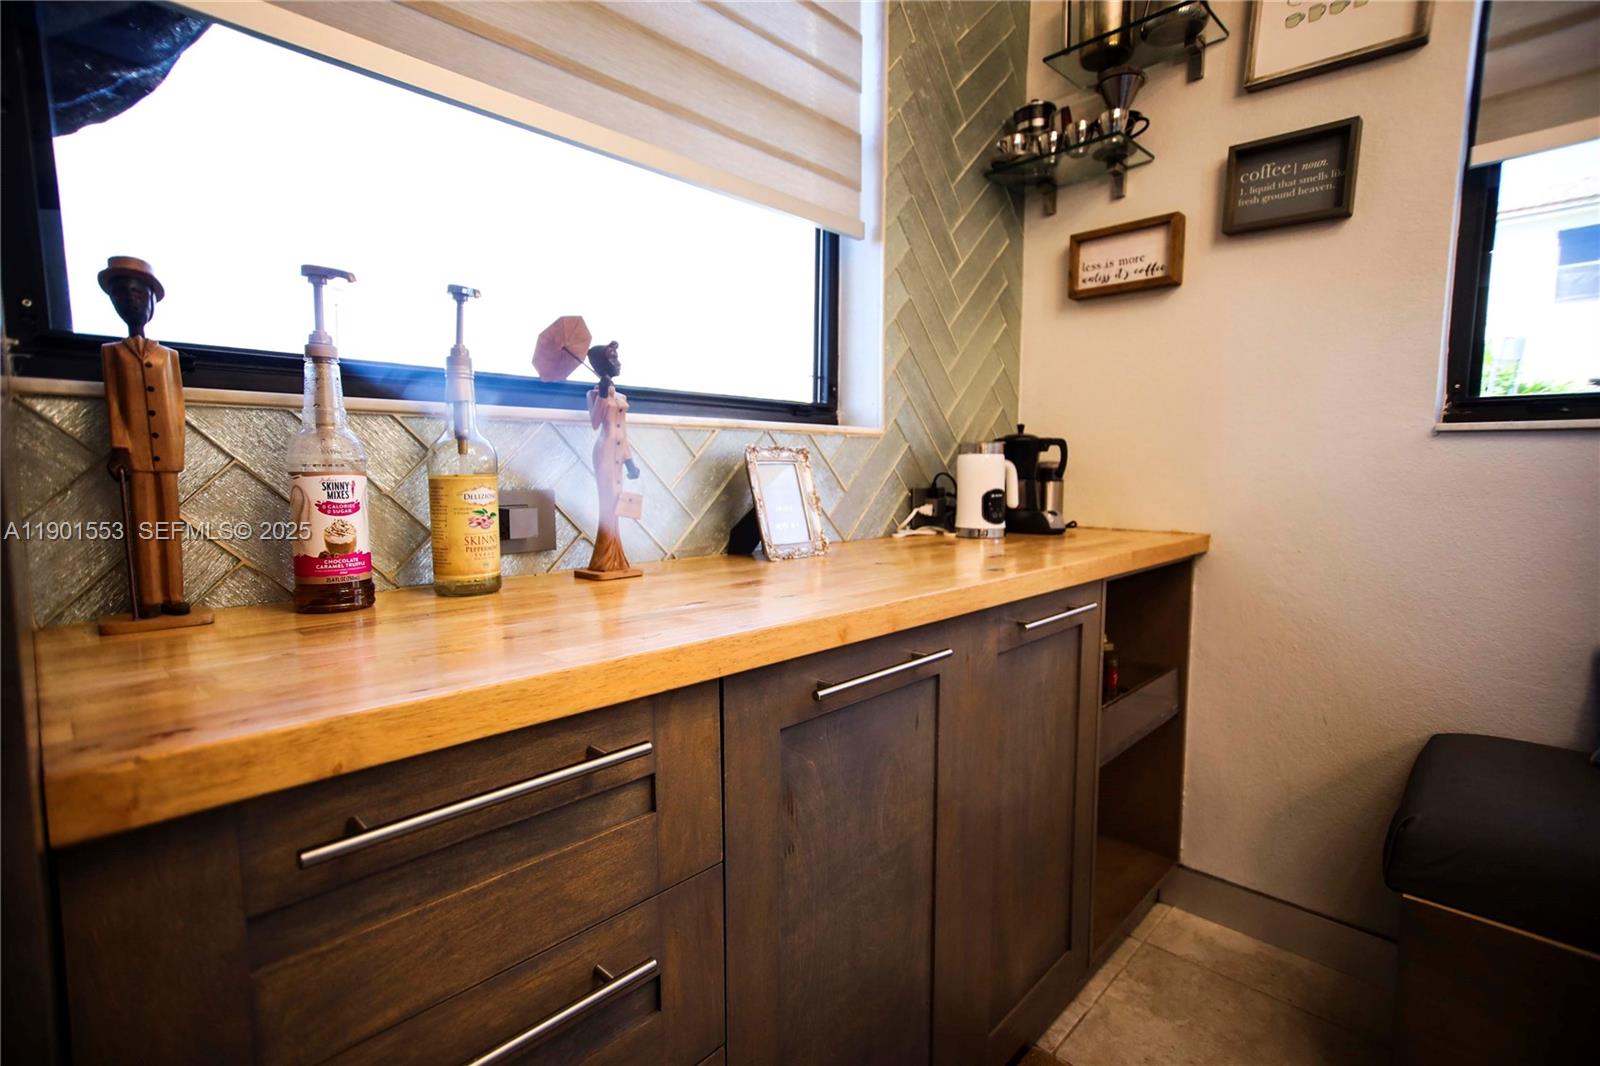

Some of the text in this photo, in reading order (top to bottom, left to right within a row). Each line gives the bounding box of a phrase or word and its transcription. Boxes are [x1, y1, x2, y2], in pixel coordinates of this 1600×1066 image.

[1240, 162, 1291, 183] coffee
[1301, 159, 1329, 171] noun.
[1249, 182, 1276, 195] liquid
[1278, 179, 1296, 190] that
[1299, 171, 1328, 185] smells
[1238, 183, 1336, 207] fresh ground heaven.
[1082, 254, 1146, 272] less is more
[321, 481, 350, 491] SKINNY
[326, 490, 350, 500] MIXES
[323, 557, 359, 565] CHOCOLATE
